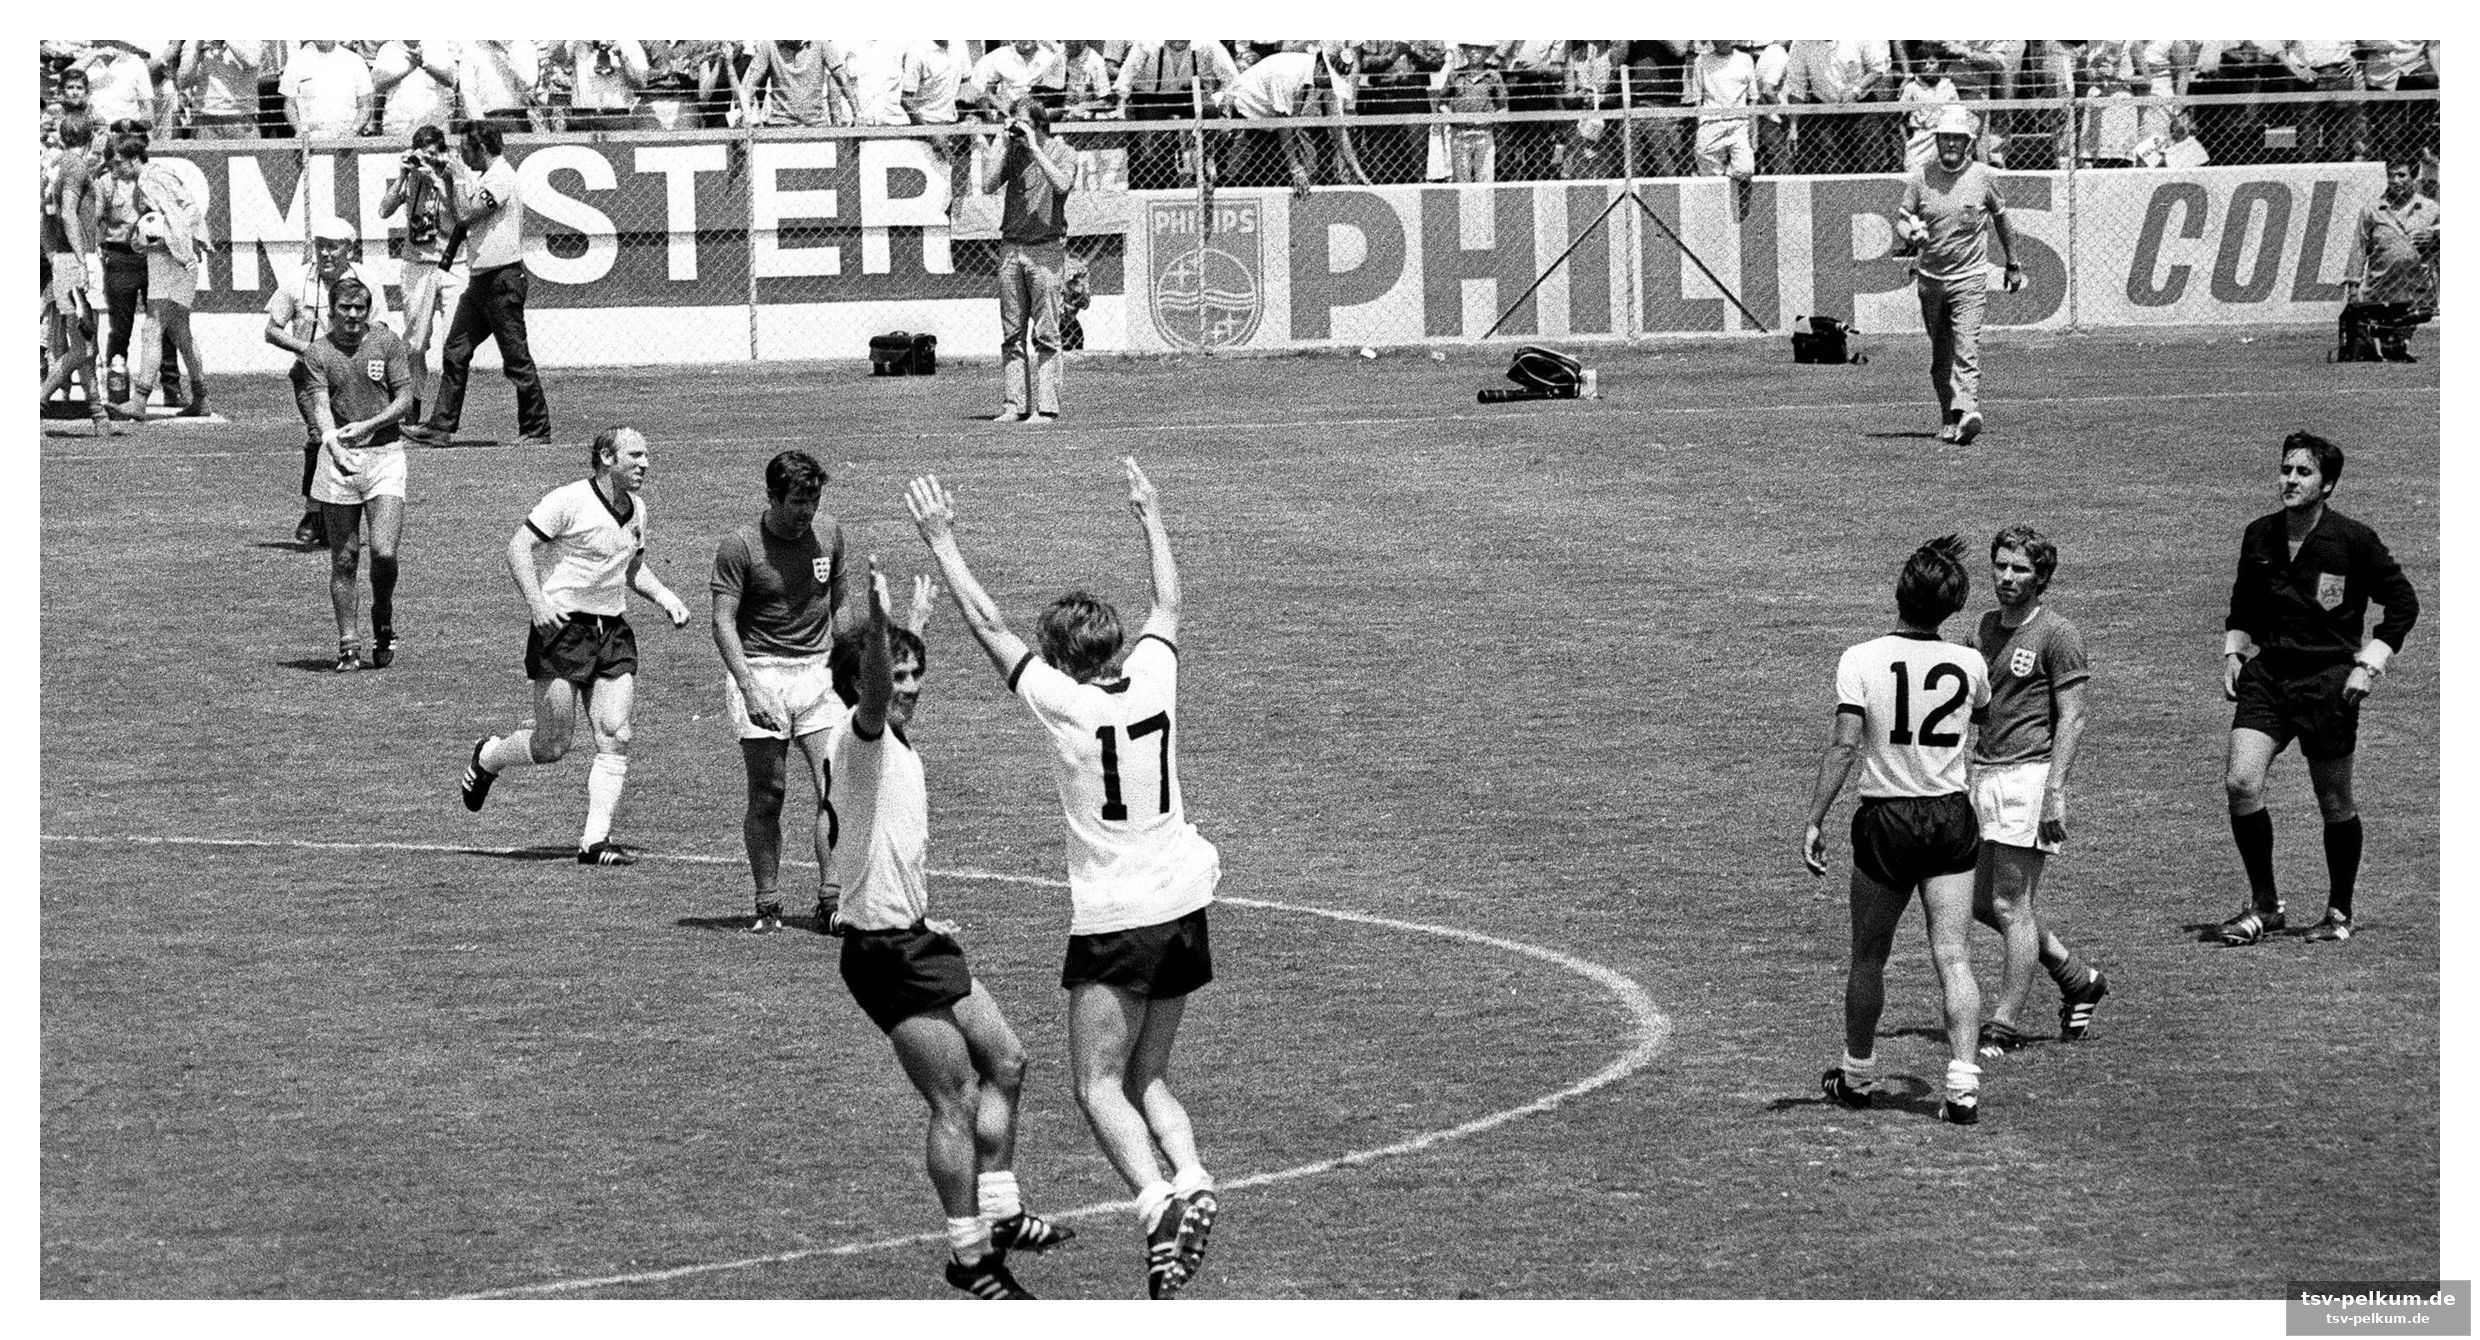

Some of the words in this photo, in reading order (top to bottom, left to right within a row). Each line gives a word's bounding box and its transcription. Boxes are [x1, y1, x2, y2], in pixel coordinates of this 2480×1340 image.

[148, 139, 956, 290] MESTER
[1154, 208, 1257, 235] PHIIPS
[1889, 661, 1970, 747] 12
[1095, 710, 1171, 821] 17
